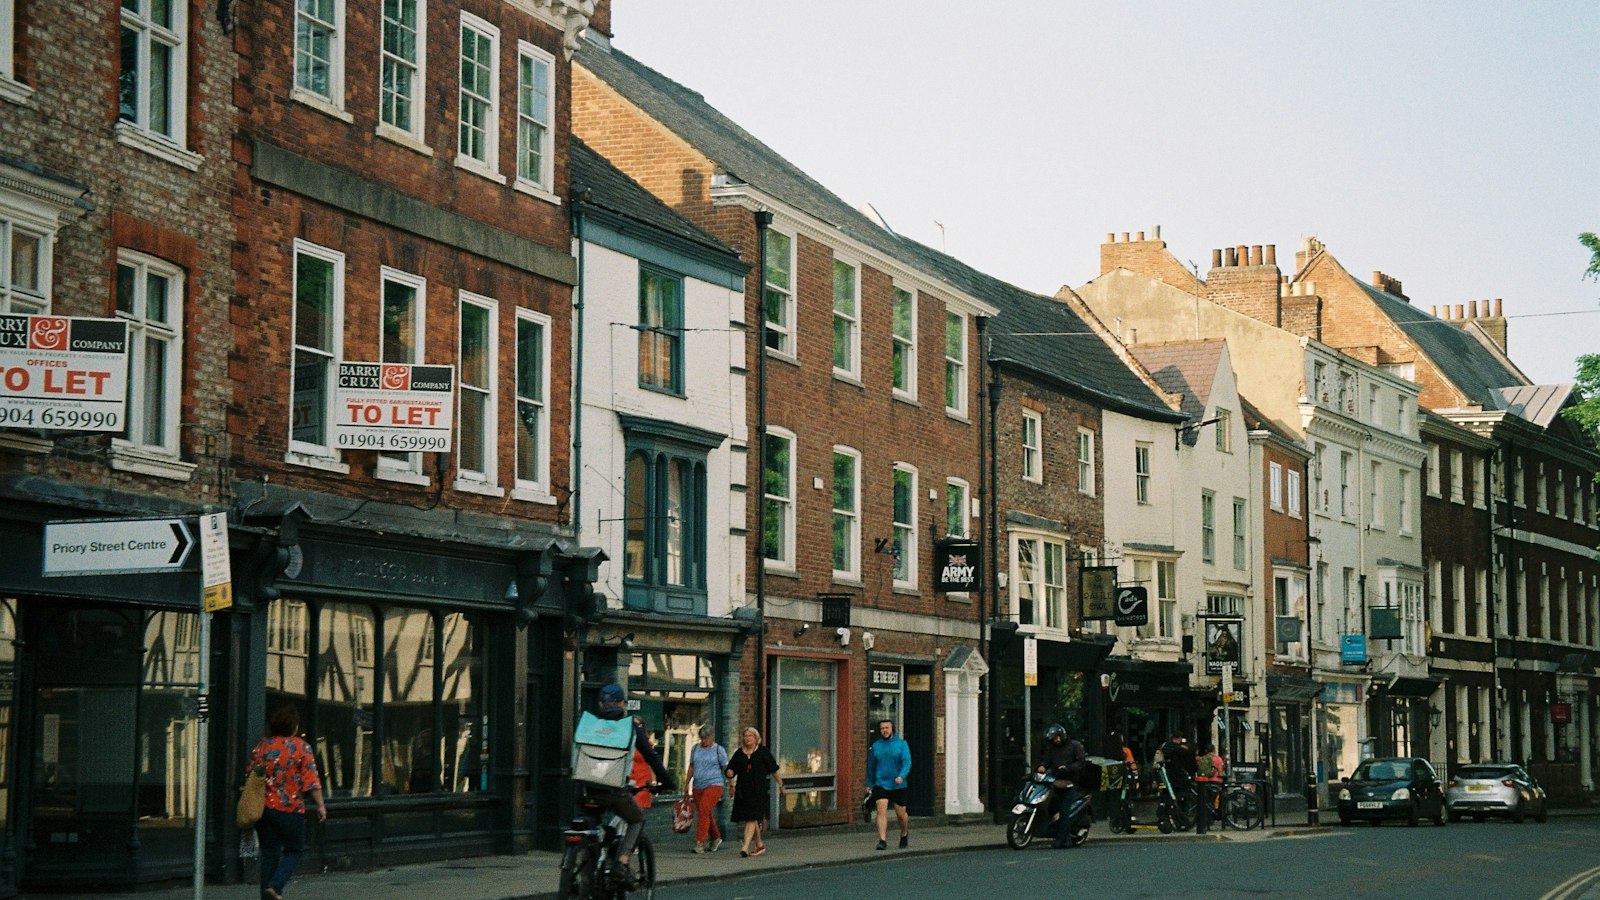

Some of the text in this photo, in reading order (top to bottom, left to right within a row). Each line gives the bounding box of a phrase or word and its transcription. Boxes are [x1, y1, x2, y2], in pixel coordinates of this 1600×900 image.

[72, 339, 123, 351] COMPANY
[27, 359, 68, 368] OFFICES
[340, 365, 380, 377] BARRY
[0, 366, 112, 396] O LET
[339, 376, 379, 388] CRUX
[412, 381, 450, 390] COMPANY
[41, 407, 118, 428] 659990
[347, 404, 441, 426] TO LET
[338, 433, 447, 450] 01904 659990
[52, 539, 167, 555] Priory Street Centre
[941, 565, 975, 577] ARMY
[1083, 591, 1113, 600] RATTLE
[873, 670, 899, 684] BE THE BEST
